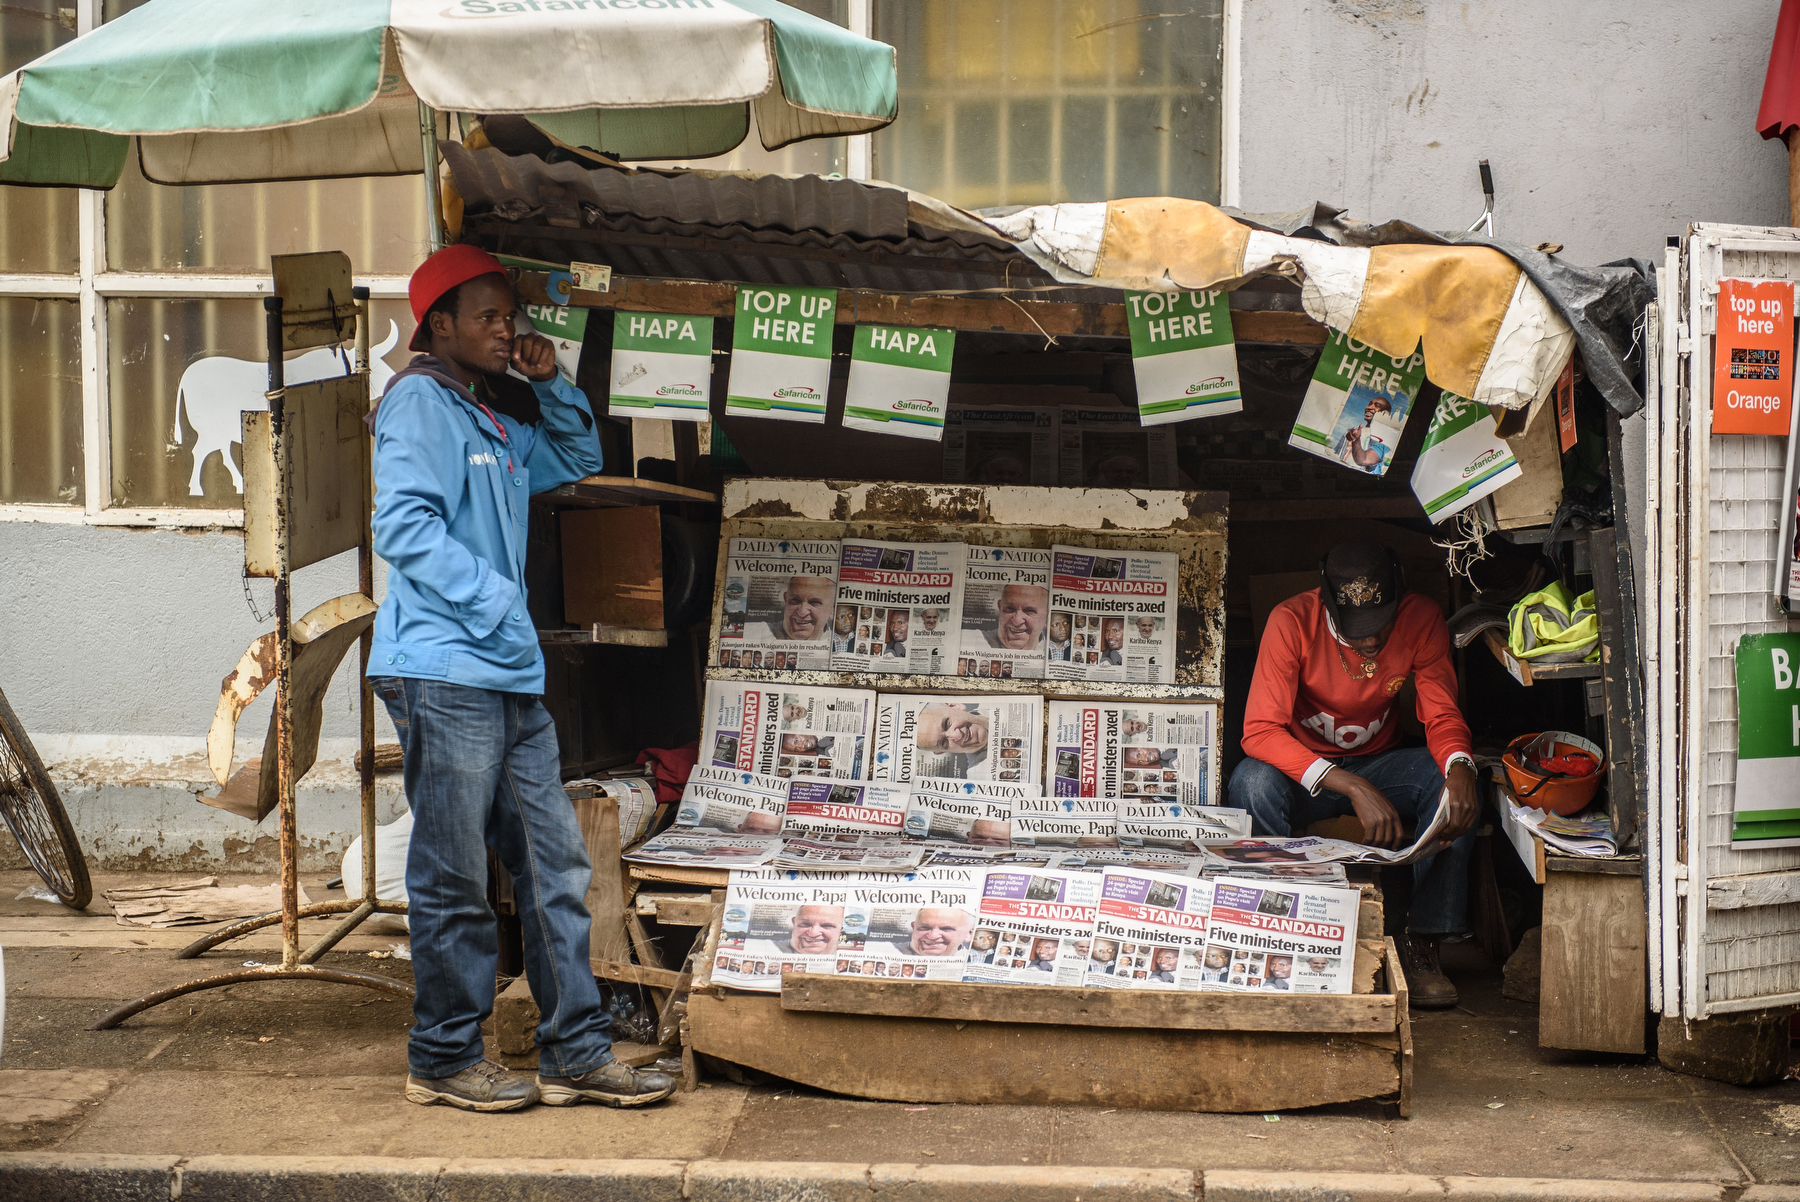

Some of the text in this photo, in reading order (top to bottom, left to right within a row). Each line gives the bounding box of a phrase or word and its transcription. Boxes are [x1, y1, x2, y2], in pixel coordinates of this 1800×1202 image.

[741, 289, 832, 319] TOP UP
[1129, 291, 1221, 318] TOP UP
[1730, 294, 1781, 318] top up
[522, 304, 569, 326] ERE
[1738, 314, 1774, 334] here
[630, 316, 696, 341] HAPA
[752, 317, 816, 345] HERE
[1149, 312, 1213, 342] HERE
[870, 327, 937, 357] HAPA
[1336, 354, 1402, 396] HERE
[660, 385, 702, 396] Safaricom
[778, 388, 821, 400] Safaricom
[1190, 380, 1233, 392] Safaricom
[897, 400, 940, 413] Safaricom
[1727, 389, 1781, 414] Orange
[1428, 395, 1466, 434] ERE
[1464, 449, 1504, 475] Safaricom
[738, 541, 838, 554] DAILY NATION
[967, 549, 1051, 563] ILY NATION
[734, 560, 832, 576] Welcome, Papa
[1015, 570, 1046, 585] Papa
[873, 572, 951, 586] STANDARD
[1086, 580, 1164, 594] STANDARD
[838, 586, 950, 605] Five ministers axed
[1052, 594, 1165, 613] Five ministers axed
[1771, 648, 1800, 690] B
[739, 693, 758, 769] STANDARD
[1104, 710, 1118, 736] axed
[758, 693, 779, 775] ministers axed
[876, 705, 892, 781] ILY NATION
[897, 710, 917, 783] lcome, Papa
[1083, 711, 1097, 785] STANDARD
[1102, 739, 1118, 790] ministers
[699, 768, 788, 791] DAILY NATIO
[921, 780, 1026, 798] DAILY NATION
[694, 785, 756, 810] Welcome,
[760, 797, 785, 816] Pap
[917, 796, 1011, 821] Welcome, Pap
[1020, 800, 1117, 813] DAILY NATIO
[821, 805, 902, 825] STANDARD
[1126, 806, 1169, 818] DAILY
[785, 819, 810, 830] Five
[813, 824, 869, 835] ministers
[1018, 819, 1085, 836] Welcome,
[1124, 824, 1228, 841] Welcome, Papa
[740, 869, 849, 881] DAILY NATIO
[857, 869, 972, 883] DAILY NATION
[736, 886, 808, 903] Welcome,
[855, 889, 966, 907] Welcome, Papa
[1219, 890, 1236, 898] 24-page
[1320, 896, 1340, 904] Donors
[1018, 902, 1095, 921] STANDAR
[1137, 907, 1207, 929] STANDA
[1302, 914, 1328, 922] roadmap,
[977, 917, 1005, 928] Five
[1008, 921, 1072, 937] ministers
[1097, 921, 1124, 936] Five
[1127, 928, 1192, 944] ministers
[1250, 915, 1341, 939] STANDARD
[1209, 927, 1237, 943] Five
[1240, 933, 1305, 953] ministers
[1308, 944, 1342, 956] axed
